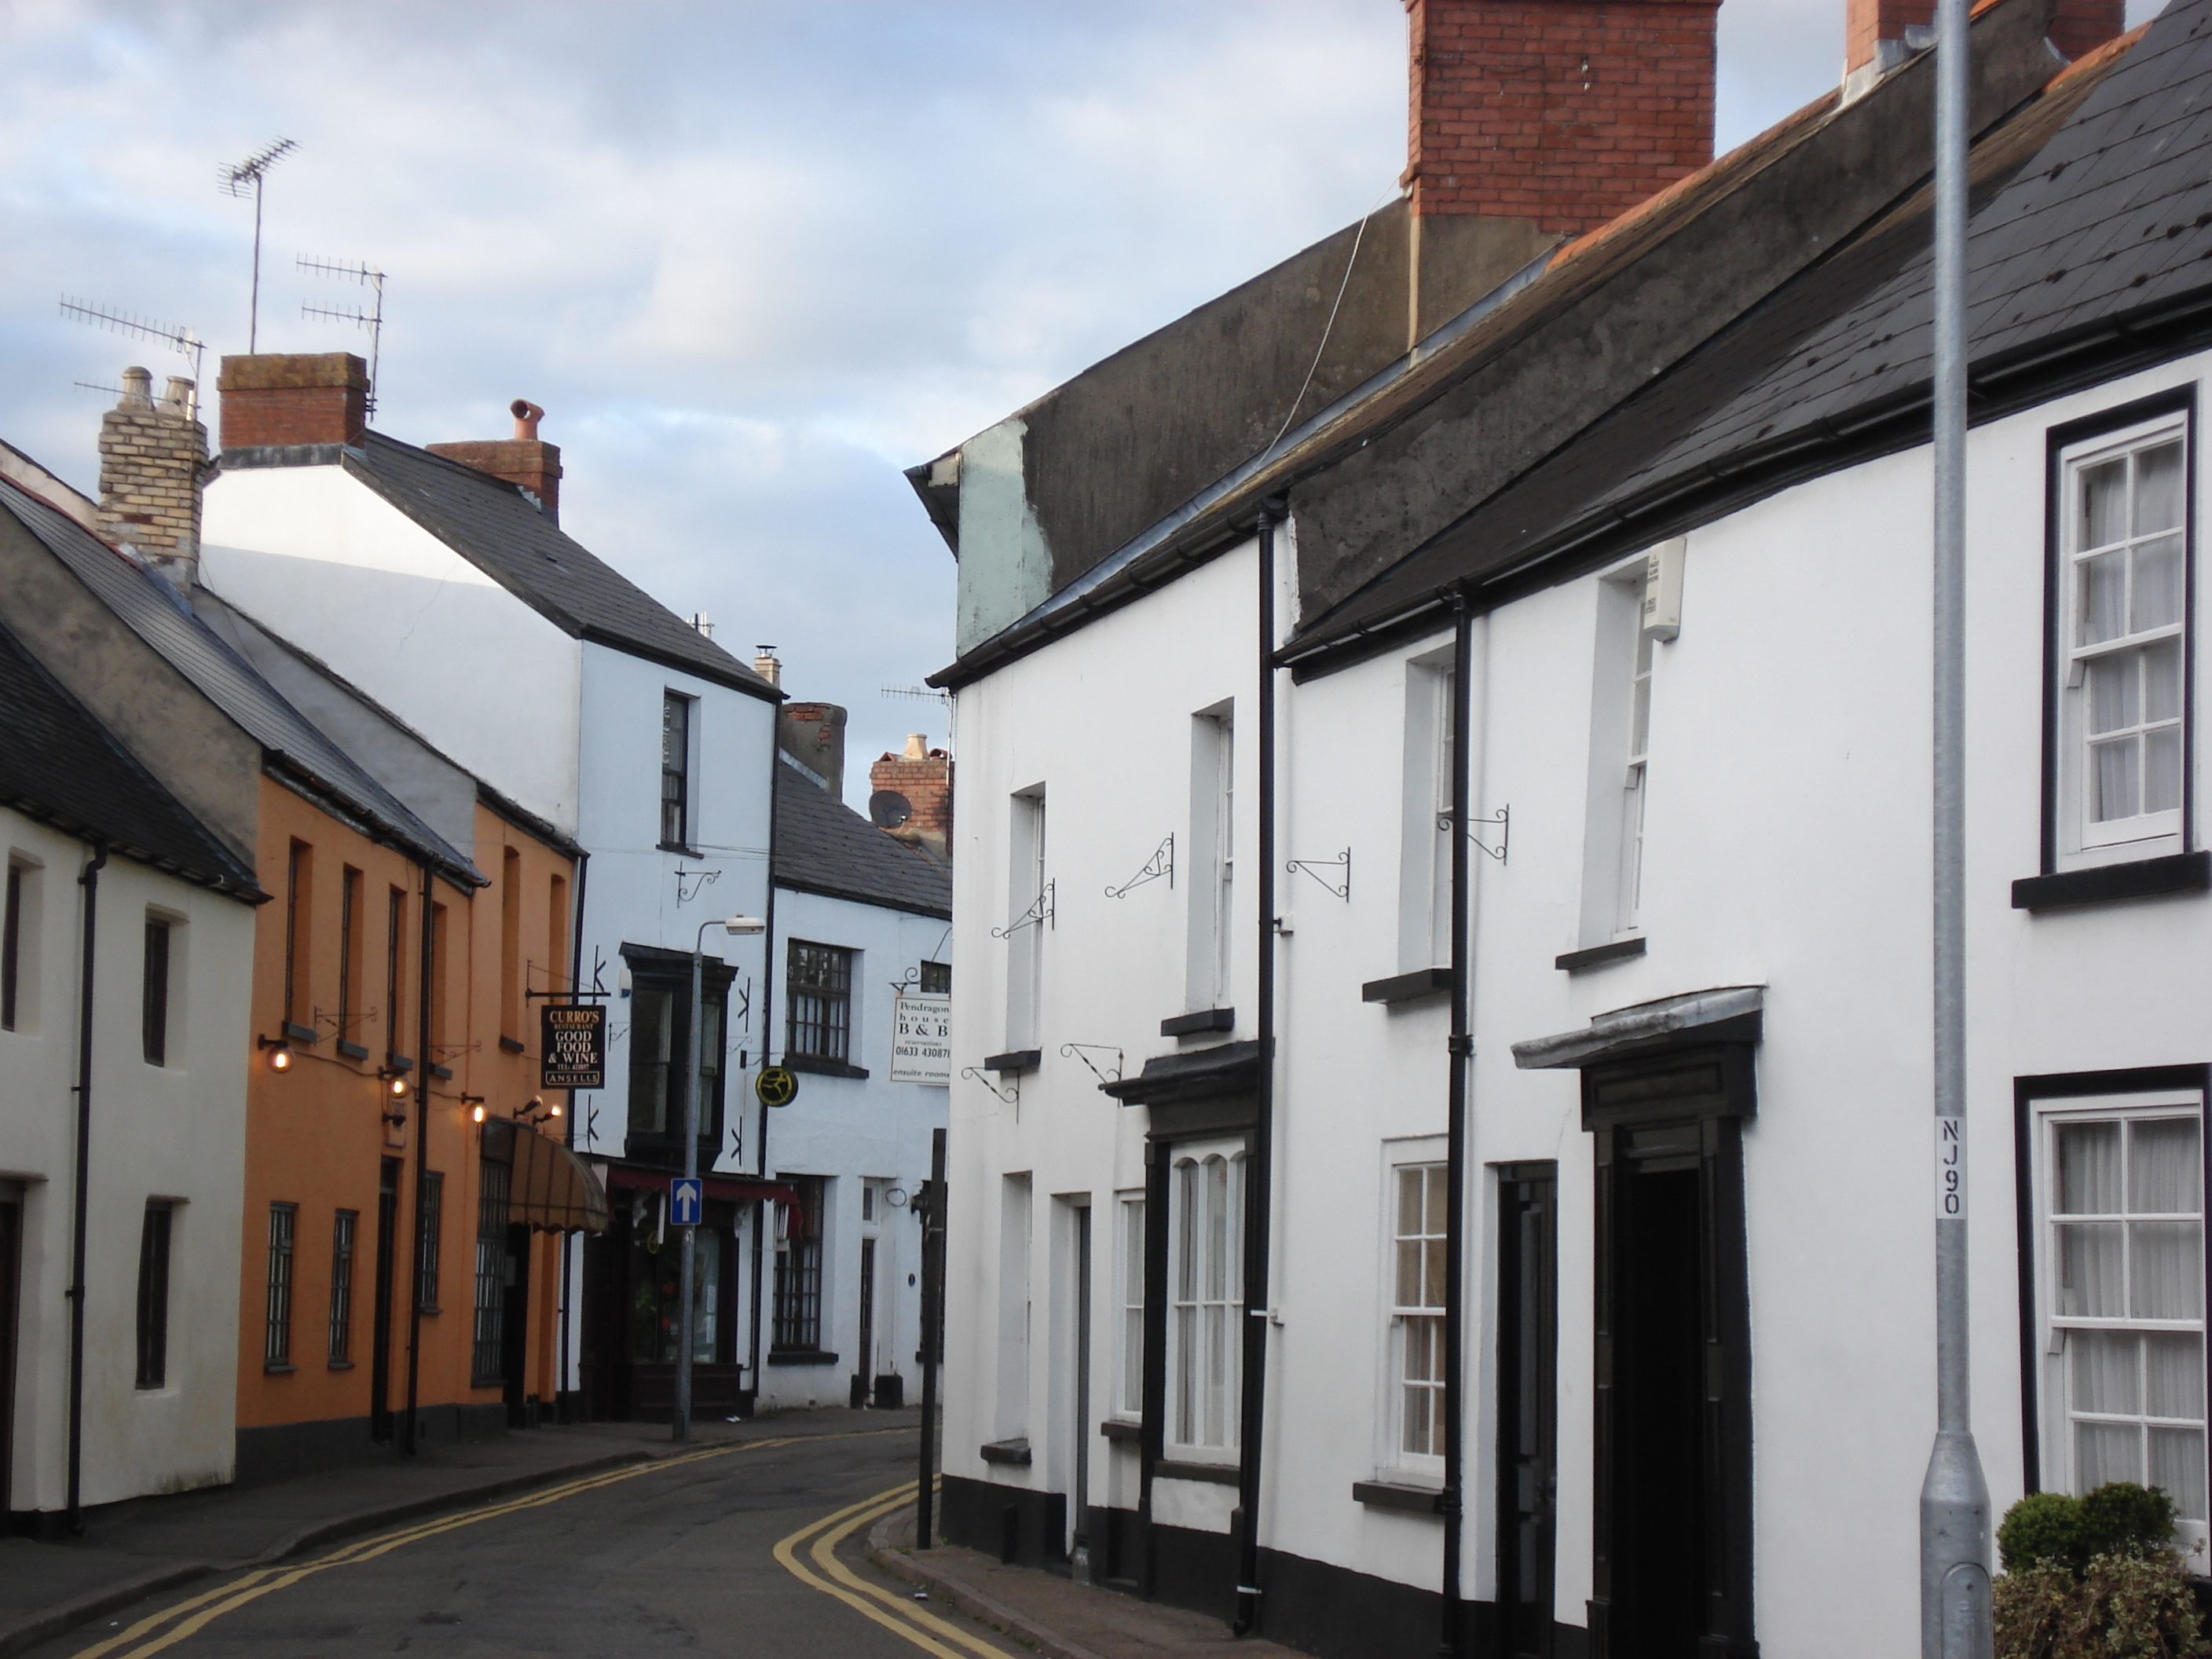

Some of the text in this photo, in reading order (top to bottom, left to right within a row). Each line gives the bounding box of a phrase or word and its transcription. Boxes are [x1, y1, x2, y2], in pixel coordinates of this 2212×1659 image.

[900, 1002, 950, 1013] Pendragon
[550, 1010, 599, 1024] CURRO'S
[899, 1013, 949, 1024] house
[899, 1023, 948, 1037] B & B
[555, 1031, 592, 1042] GOOD
[557, 1042, 591, 1053] FOOD
[895, 1046, 950, 1059] 01633 430871
[548, 1053, 598, 1064] & WINE
